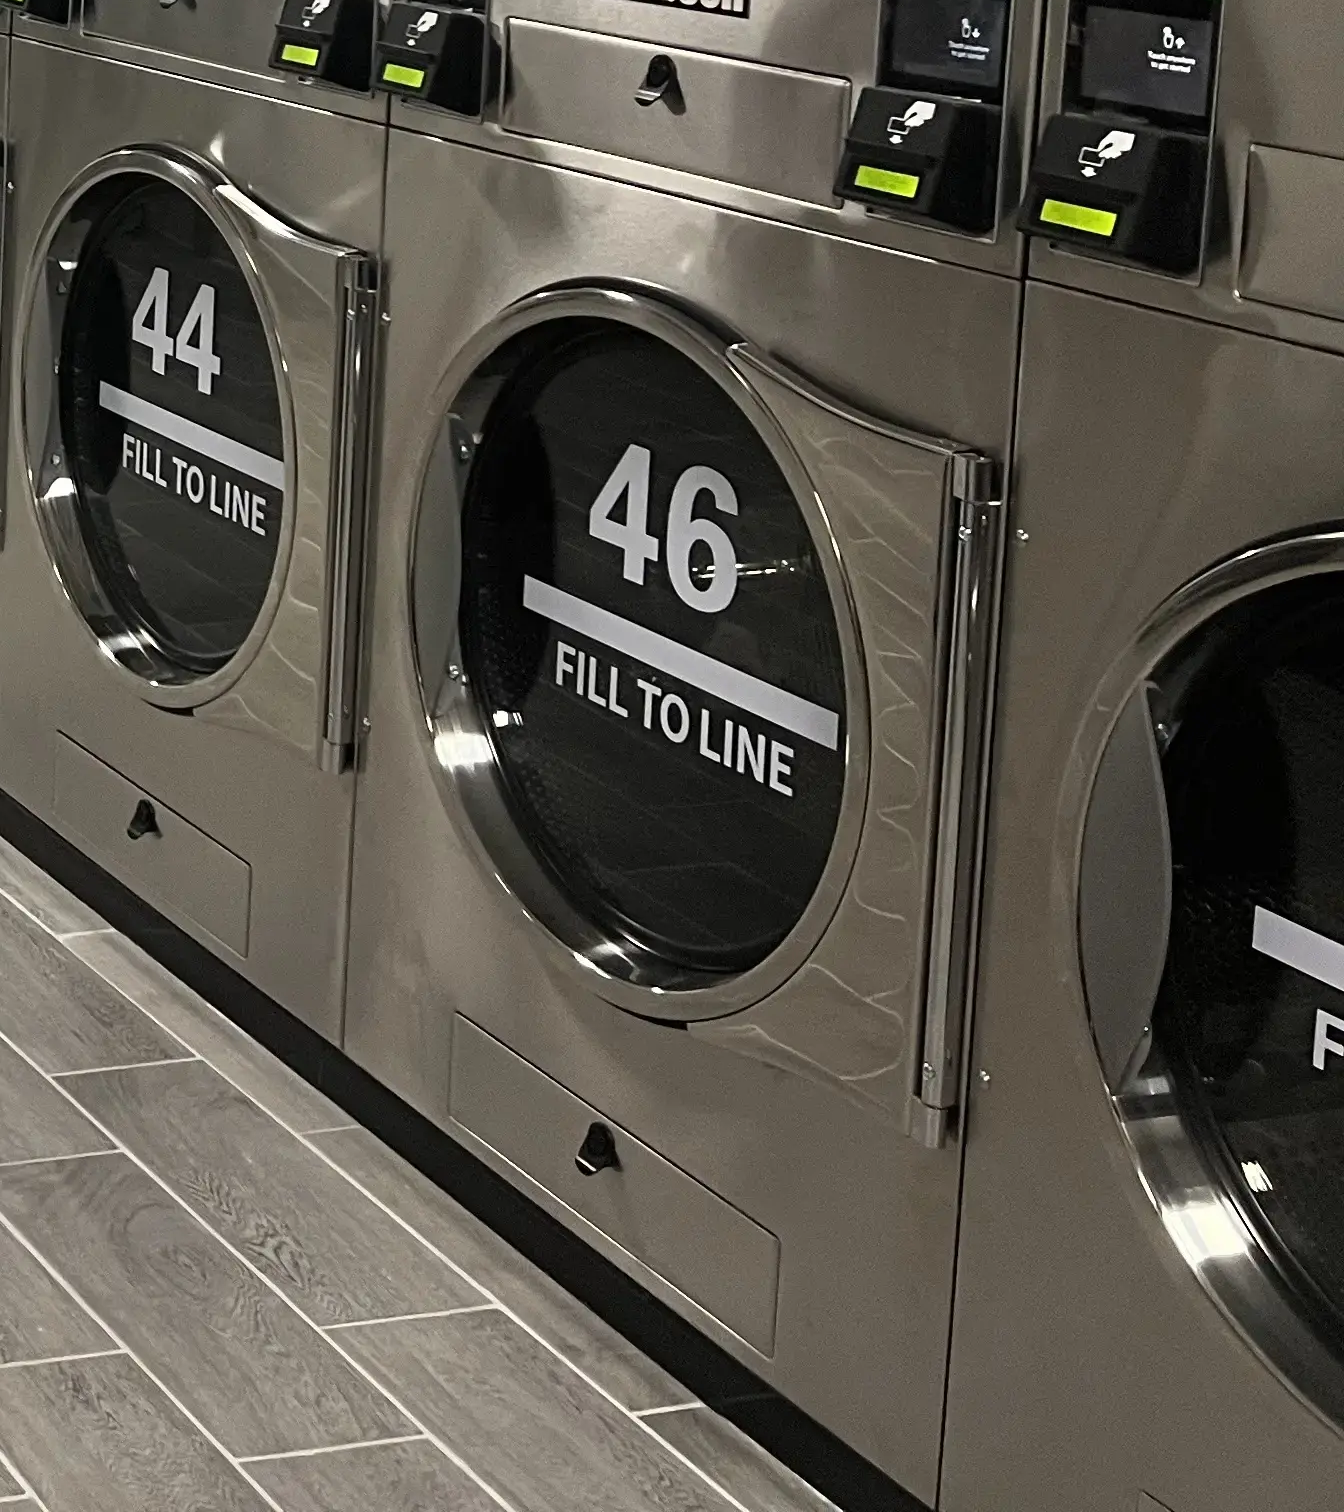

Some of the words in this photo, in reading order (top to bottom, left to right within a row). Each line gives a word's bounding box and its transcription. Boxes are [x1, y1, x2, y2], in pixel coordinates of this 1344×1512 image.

[131, 266, 222, 396] 44
[121, 432, 167, 489] FILL
[171, 454, 205, 504] TO
[210, 472, 267, 537] LINE
[589, 442, 739, 613] 46
[555, 640, 628, 719] FILL
[637, 677, 690, 744] TO
[699, 707, 795, 797] LINE
